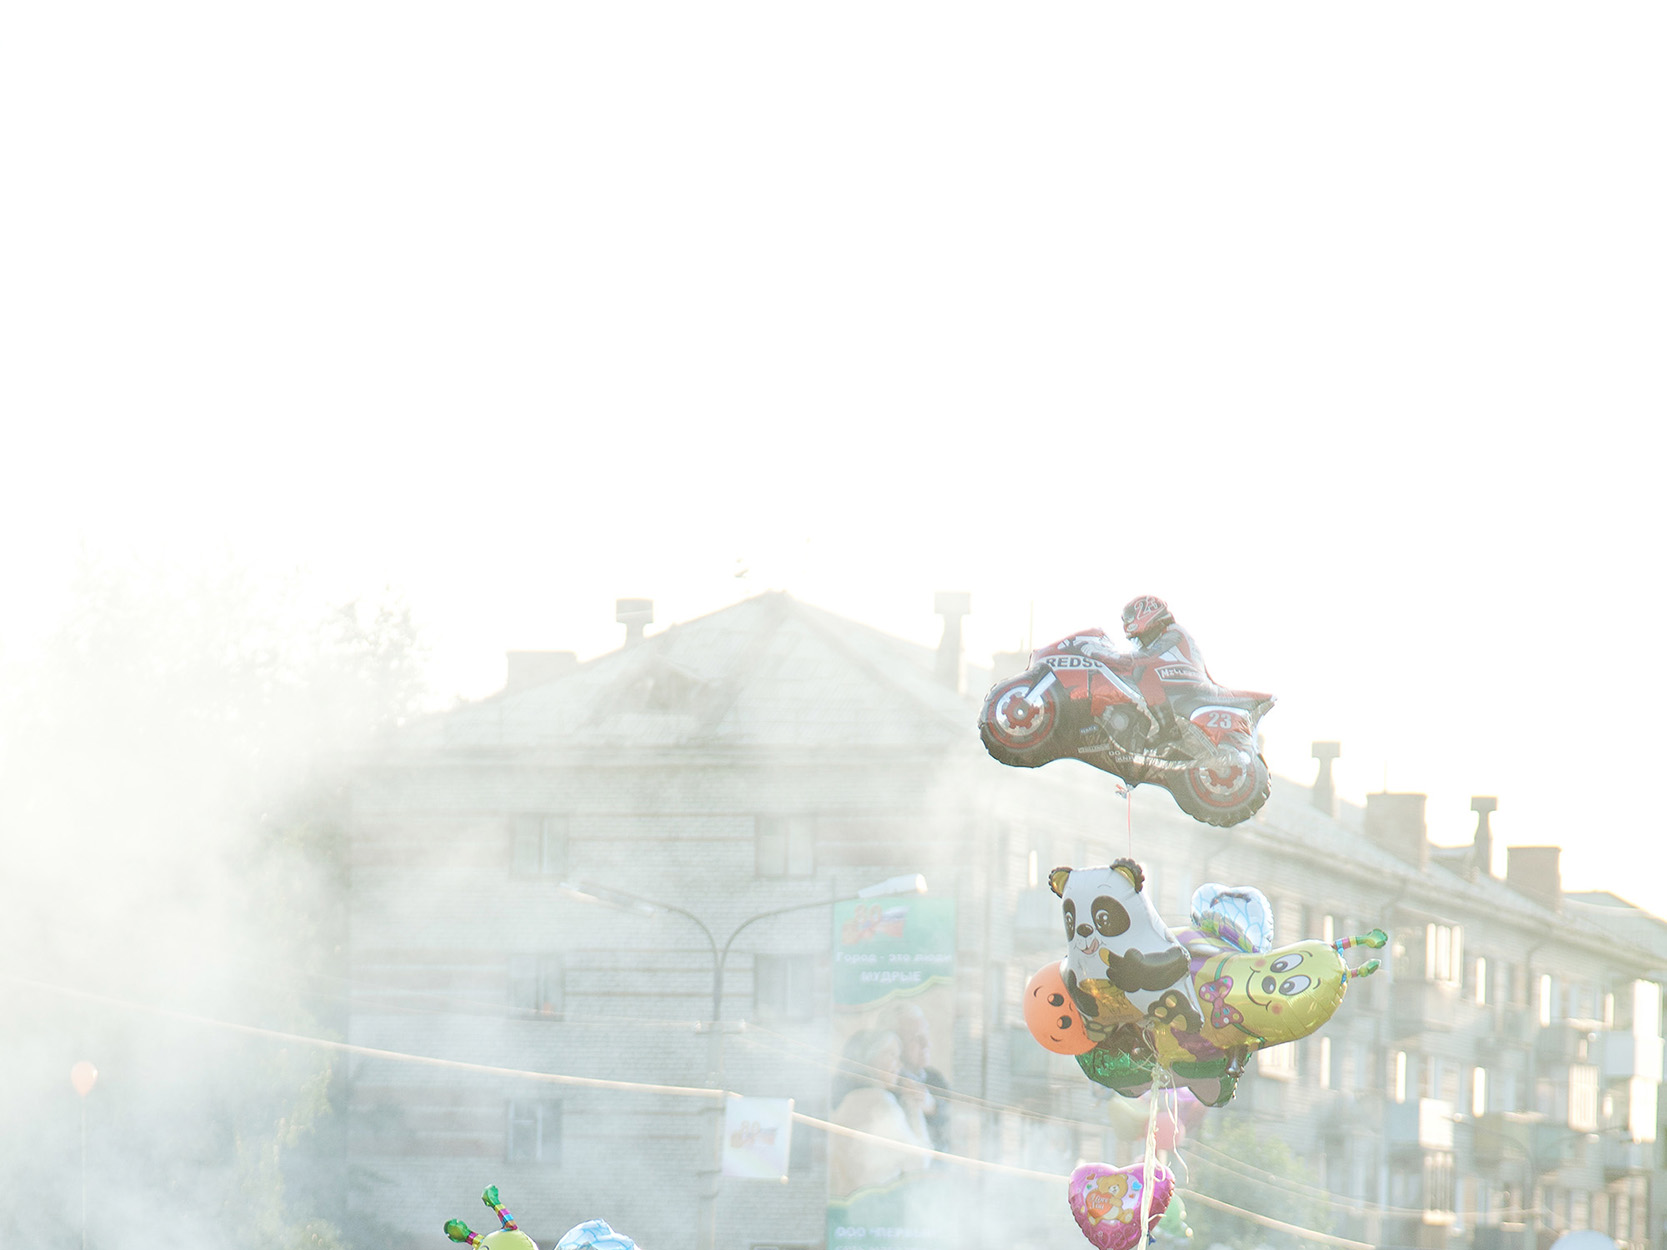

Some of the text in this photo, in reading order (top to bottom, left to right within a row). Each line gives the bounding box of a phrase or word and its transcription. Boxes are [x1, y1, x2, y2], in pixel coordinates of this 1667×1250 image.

[1206, 711, 1232, 729] 23
[836, 951, 878, 965] Город
[888, 953, 911, 963] это
[860, 971, 922, 984] МУДРЫЕ
